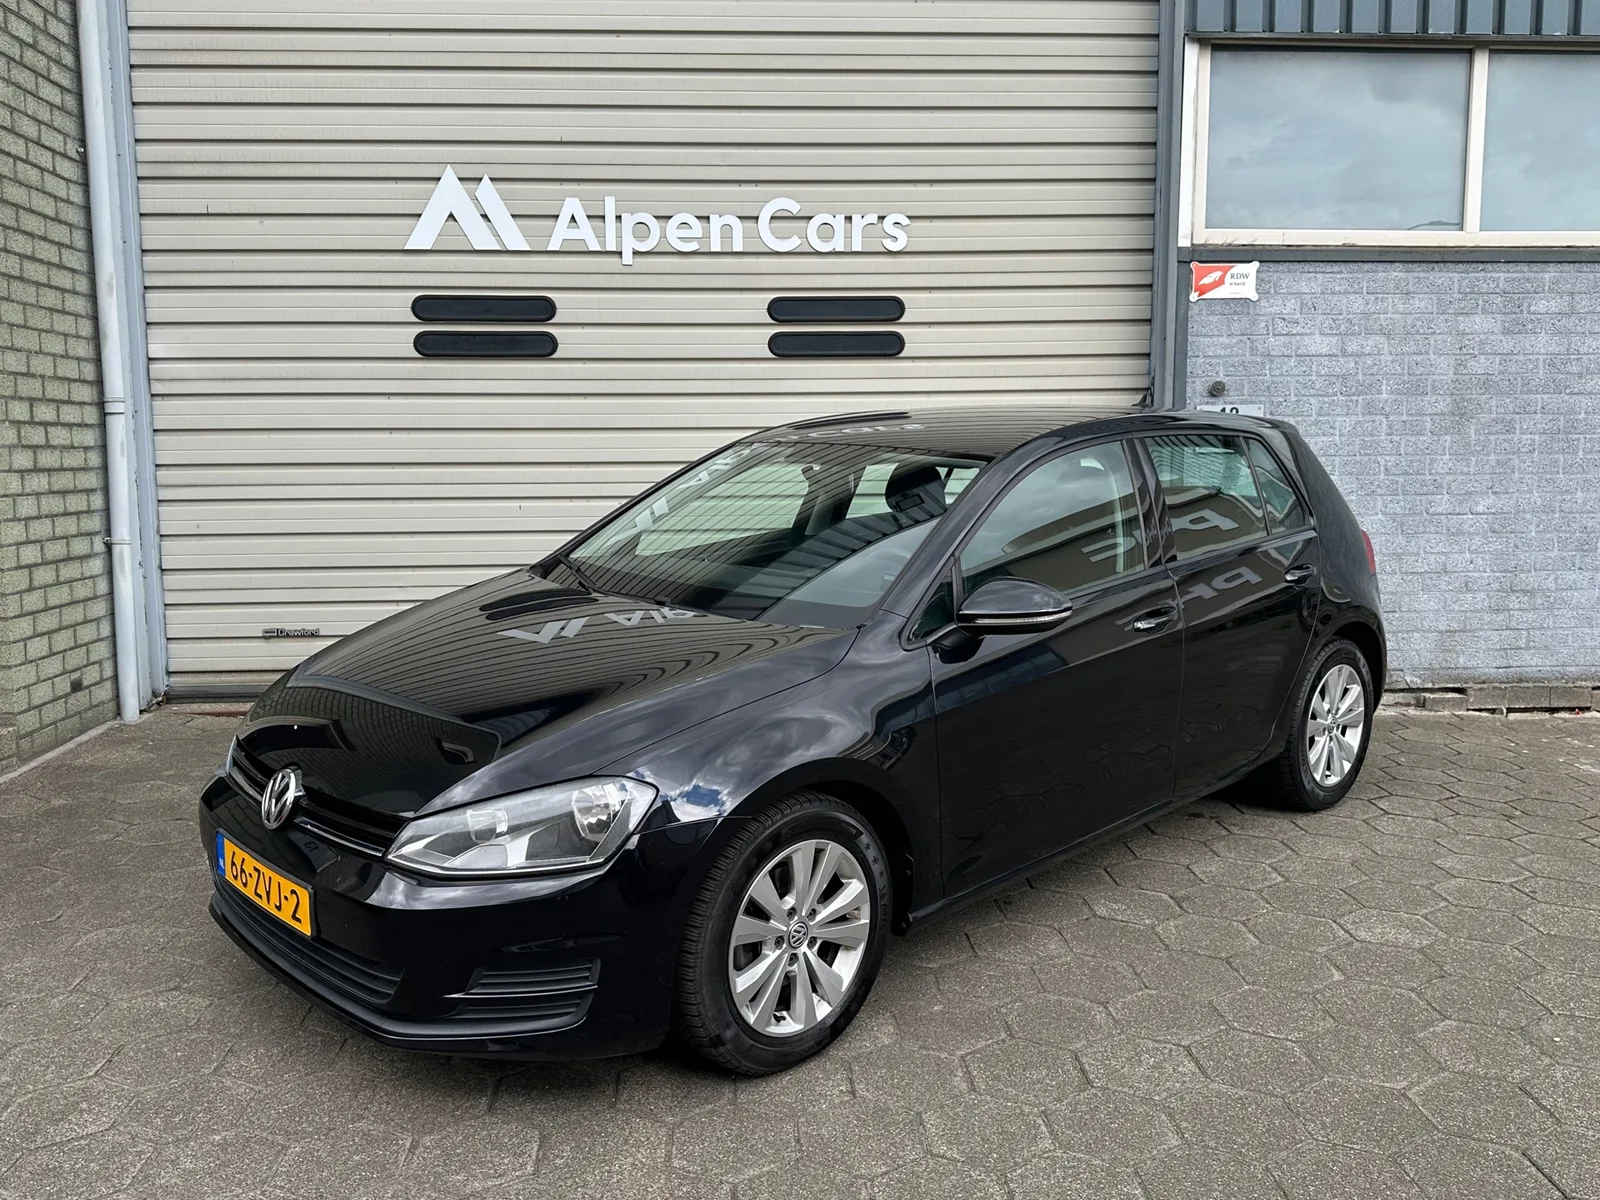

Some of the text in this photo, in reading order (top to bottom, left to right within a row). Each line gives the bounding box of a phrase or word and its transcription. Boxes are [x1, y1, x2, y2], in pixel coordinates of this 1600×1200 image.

[547, 196, 911, 266] Alpen Cars
[1230, 272, 1250, 280] RDW
[277, 628, 320, 636] Crawford
[230, 850, 302, 924] 66-ZVJ-2
